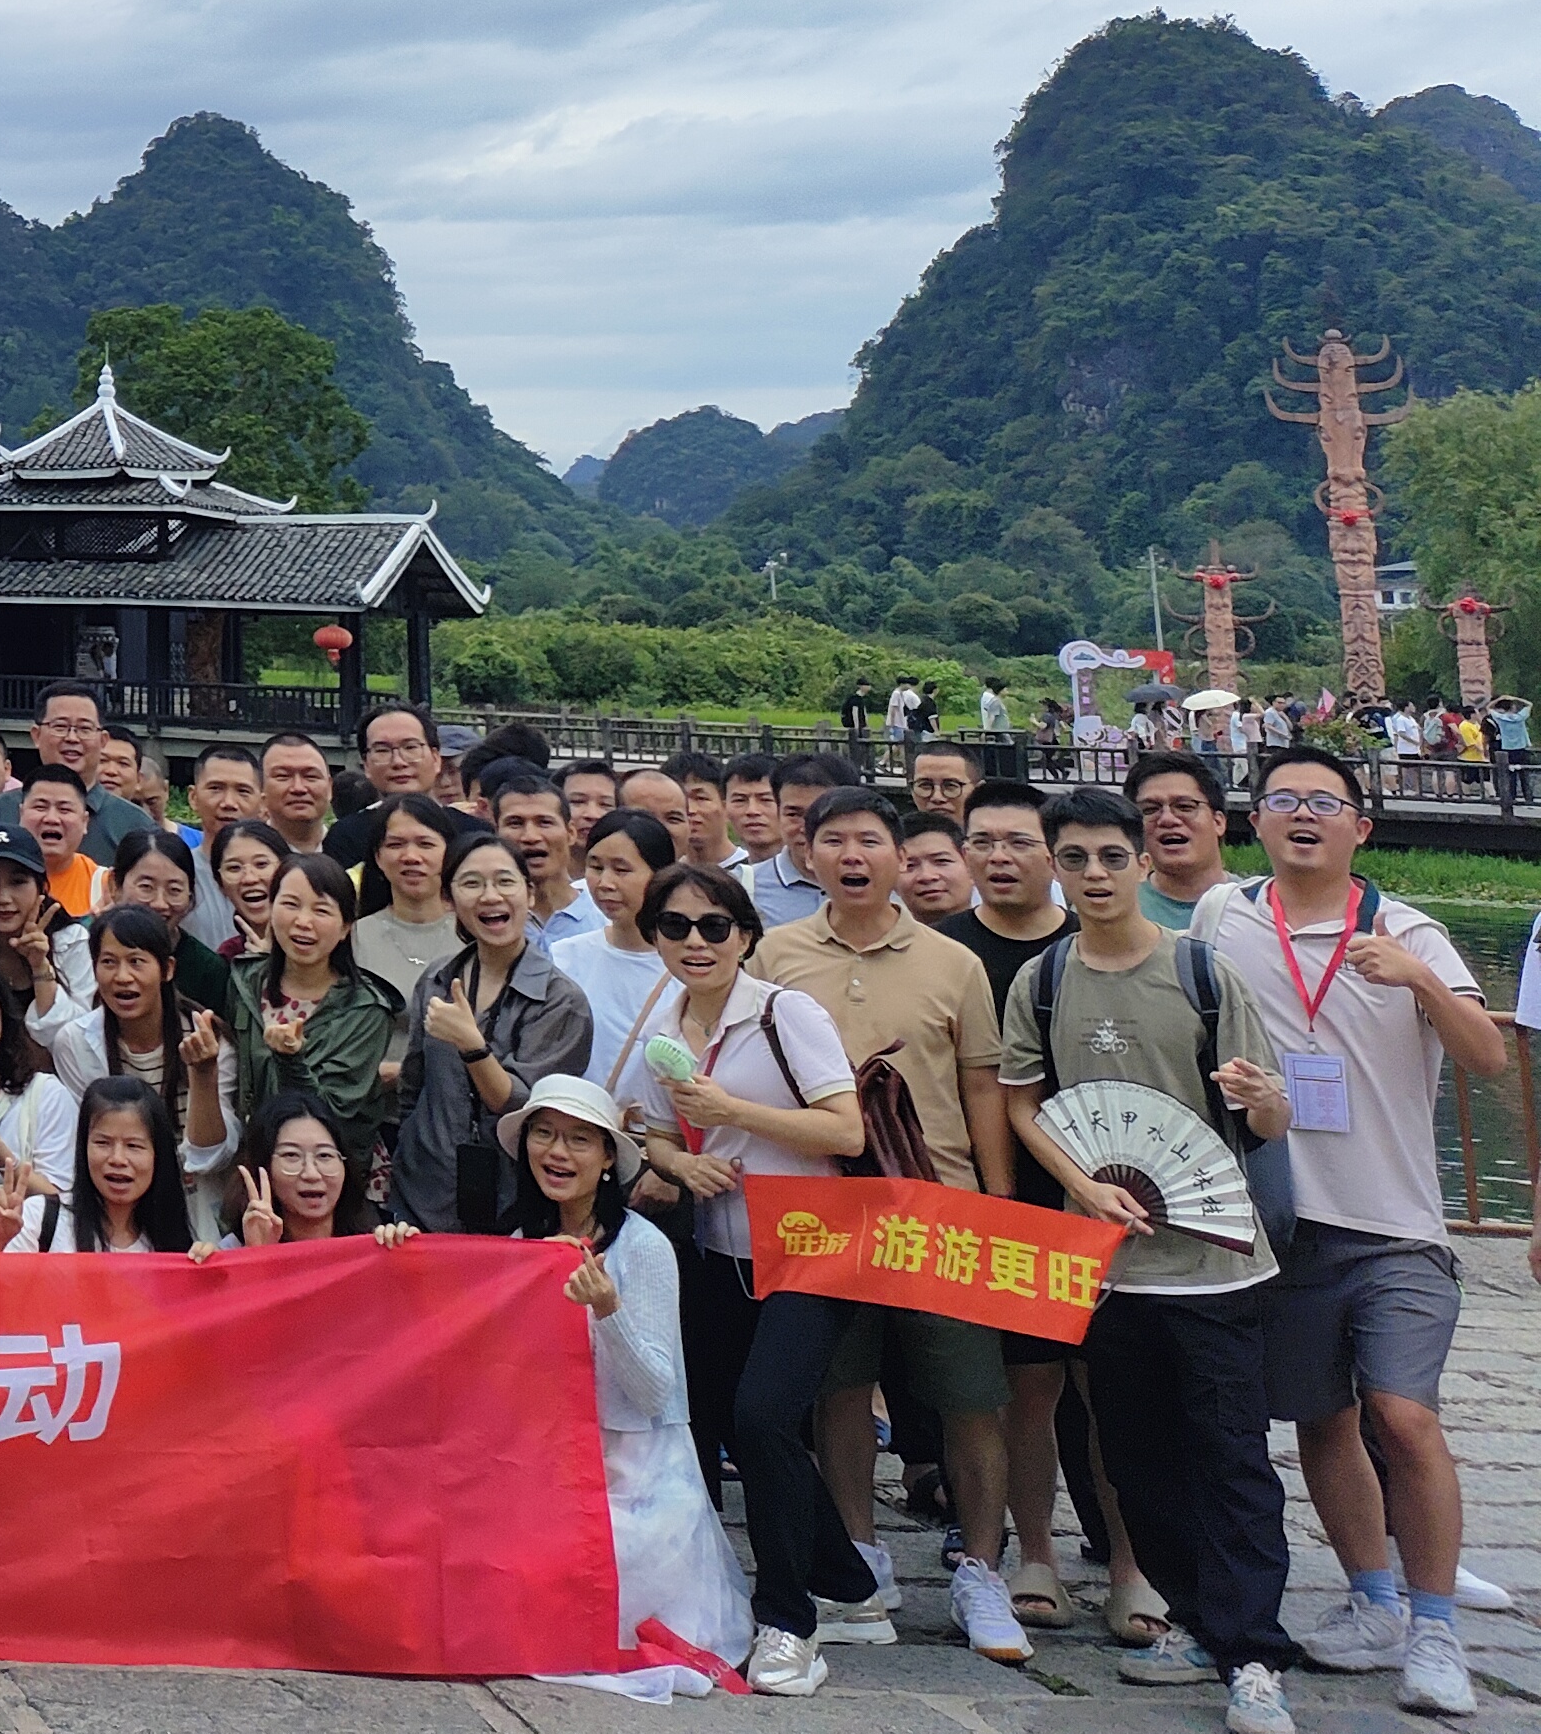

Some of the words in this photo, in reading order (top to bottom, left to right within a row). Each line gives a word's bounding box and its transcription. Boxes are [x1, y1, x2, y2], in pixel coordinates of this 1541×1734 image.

[783, 1231, 853, 1257] 旺游
[869, 1213, 1104, 1310] 游游更旺
